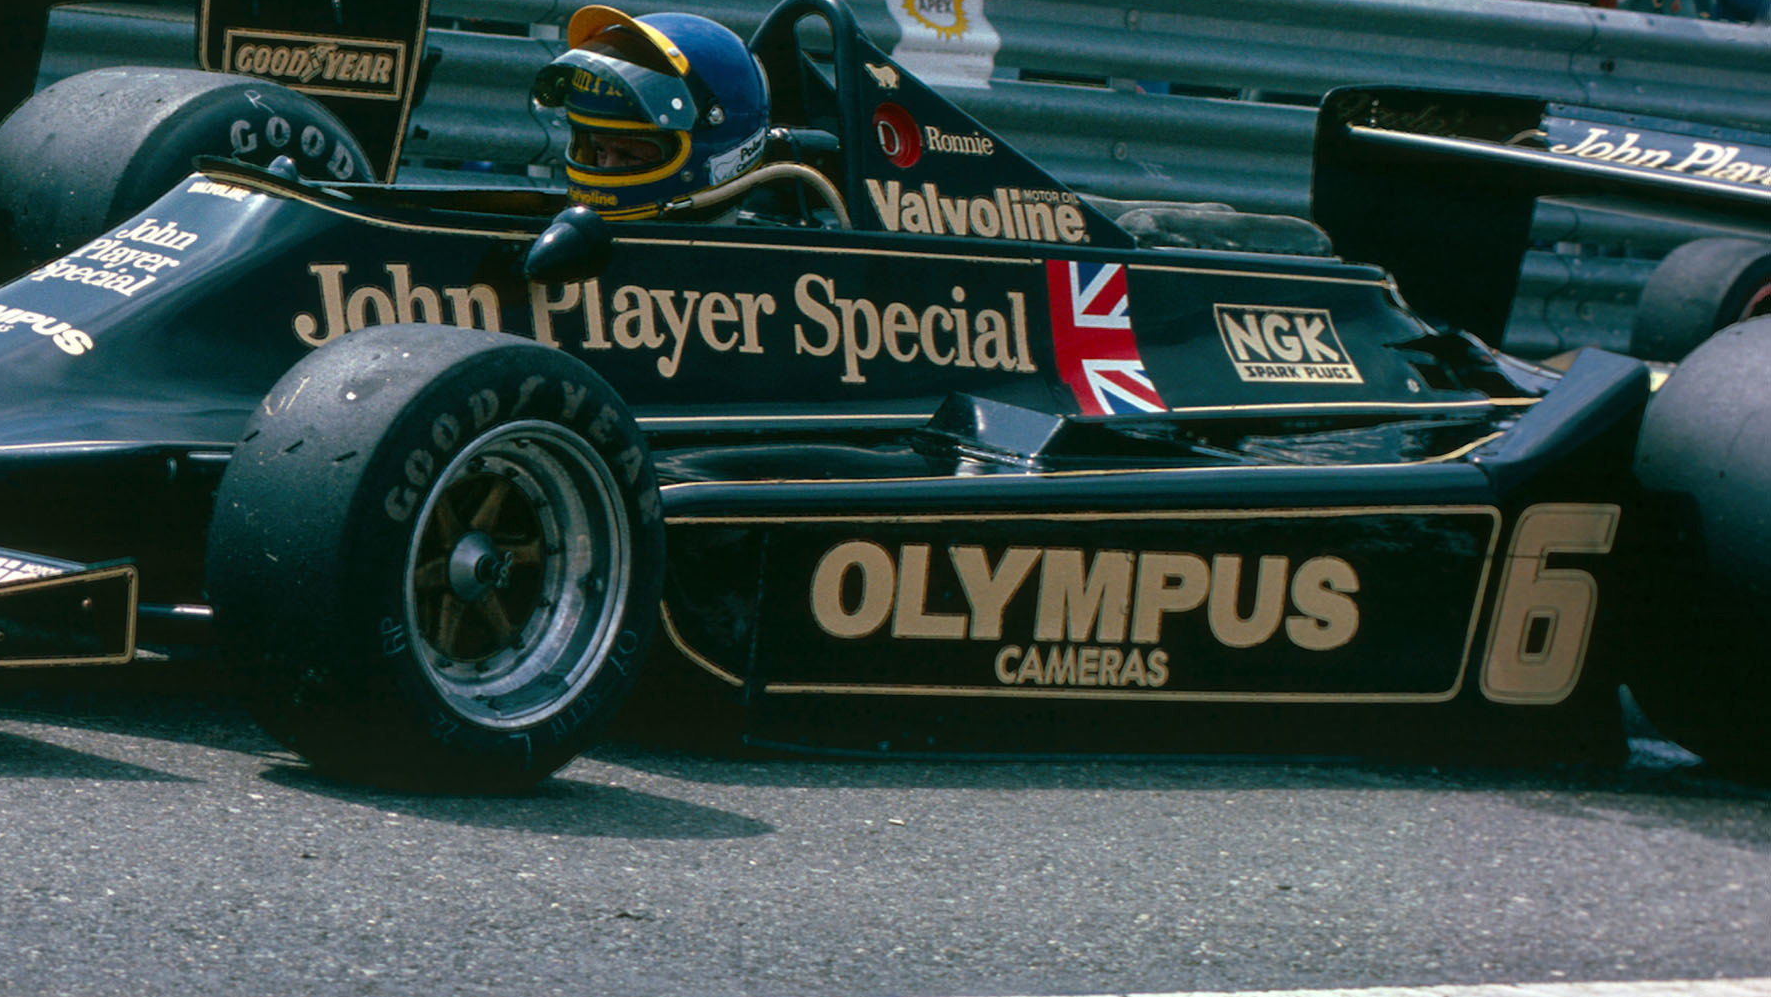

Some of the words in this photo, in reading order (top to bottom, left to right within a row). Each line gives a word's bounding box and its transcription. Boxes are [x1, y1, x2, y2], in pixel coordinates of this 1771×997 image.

[234, 41, 395, 85] GOODYEAR
[925, 125, 994, 156] Ronnie
[1550, 128, 1672, 167] John
[864, 178, 1085, 243] Valvoline
[1023, 189, 1059, 202] MOTOR
[115, 218, 198, 251] John
[71, 238, 180, 273] Player
[31, 258, 157, 297] Special
[292, 262, 501, 348] John
[530, 277, 776, 378] Player
[793, 272, 1039, 382] Special
[1222, 312, 1341, 363] NGK
[1244, 365, 1301, 378] SPARK
[1304, 367, 1353, 380] PLUGS
[809, 538, 1361, 651] OLYMPUS
[1480, 502, 1621, 705] 6
[994, 644, 1170, 687] CAMERAS
